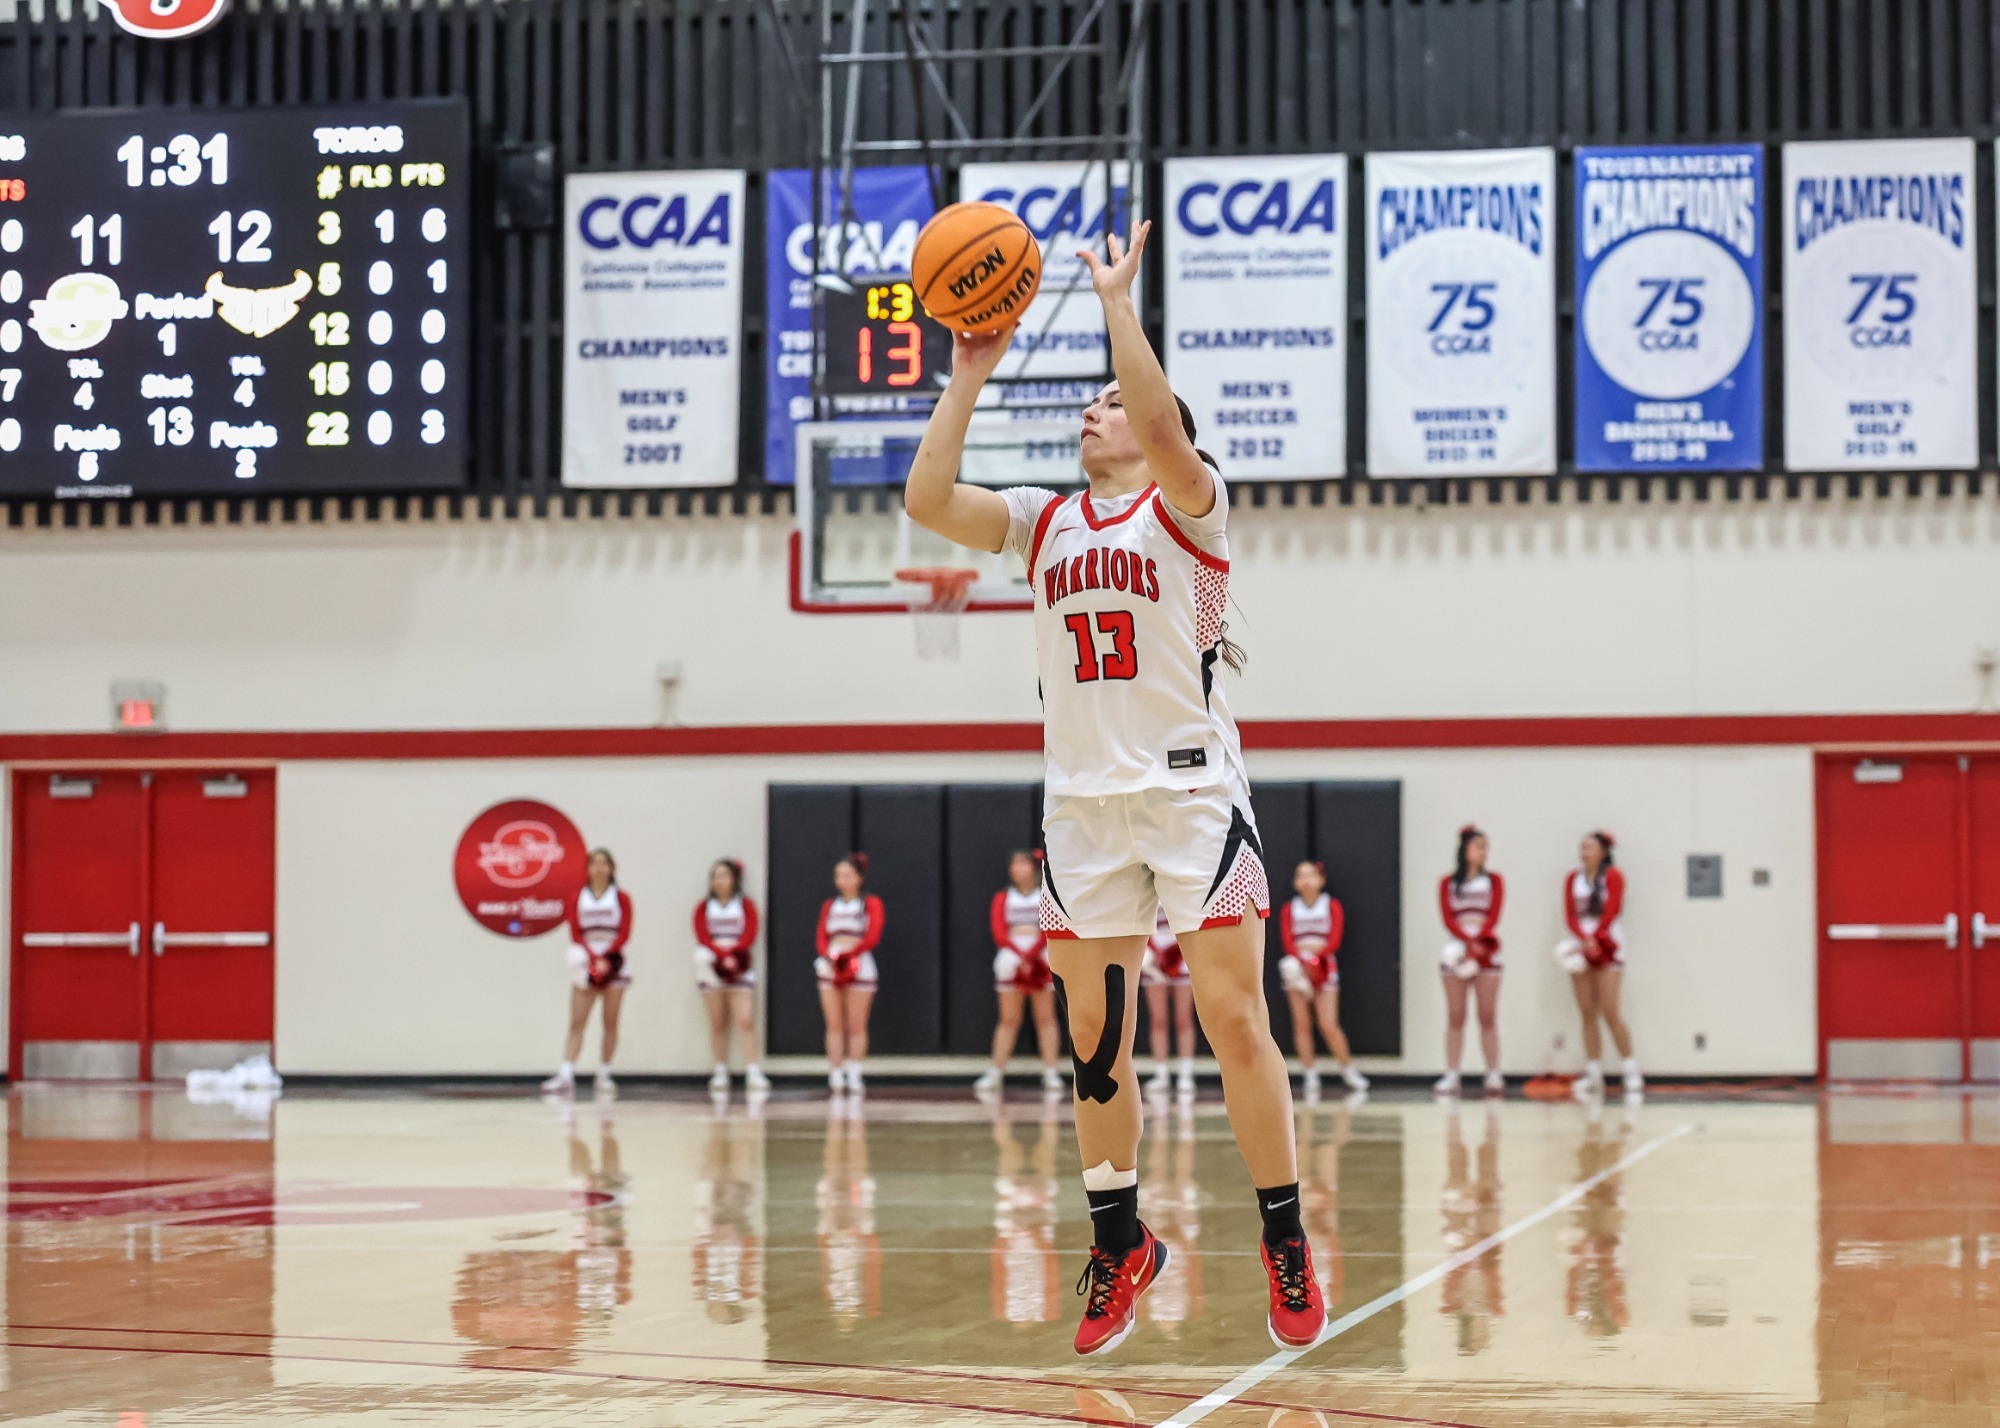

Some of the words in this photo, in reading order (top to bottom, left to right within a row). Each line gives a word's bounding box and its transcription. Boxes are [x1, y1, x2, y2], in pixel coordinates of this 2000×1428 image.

[313, 126, 404, 154] TOROS
[117, 132, 228, 187] 1:31
[350, 164, 392, 188] FLS
[400, 162, 445, 187] PTS
[1583, 155, 1755, 177] TOURNAMENT
[579, 193, 731, 250] CCAA
[1178, 179, 1335, 236] CCAA
[1378, 184, 1542, 261] CHAMPIONS
[1582, 176, 1756, 261] CHAMPIONS
[1796, 173, 1963, 252] CHAMPIONS
[0, 219, 23, 252] 0
[71, 213, 122, 266] 11
[208, 210, 272, 263] 12
[317, 211, 341, 245] 3
[375, 209, 394, 243] 1
[421, 208, 447, 242] 6
[0, 270, 22, 303] 0
[317, 262, 341, 296] 5
[368, 260, 393, 295] 0
[427, 259, 447, 293] 1
[949, 246, 1006, 300] NCAA
[135, 293, 213, 320] Period
[1427, 282, 1497, 332] 75
[1635, 278, 1705, 327] 75
[1845, 273, 1918, 324] 75
[0, 319, 22, 352] 0
[158, 323, 176, 356] 1
[308, 311, 350, 346] 12
[368, 310, 393, 345] 0
[421, 309, 446, 344] 0
[1178, 327, 1334, 350] CHAMPIONS
[1639, 331, 1699, 351] CCAA
[1851, 327, 1912, 347] CCAA
[579, 336, 729, 359] CHAMPIONS
[858, 322, 922, 386] 13
[1431, 335, 1491, 355] CCAA
[0, 368, 22, 402] 7
[141, 374, 193, 398] Shot
[233, 378, 256, 407] 4
[308, 361, 350, 396] 15
[368, 360, 393, 395] 0
[420, 359, 446, 394] 0
[1221, 381, 1291, 397] MEN'S
[73, 382, 95, 410] 4
[620, 389, 686, 405] MEN'S
[1635, 402, 1703, 420] MEN'S
[1847, 401, 1912, 415] MEN'S
[147, 406, 194, 446] 13
[306, 411, 350, 446] 22
[367, 410, 392, 445] 0
[420, 409, 445, 444] 3
[627, 415, 678, 432] GOLF
[1215, 409, 1297, 425] SOCCER
[1604, 420, 1734, 442] BASKETBALL
[0, 418, 21, 451] 0
[54, 424, 121, 451] Fouls
[210, 420, 278, 448] Fouls
[1228, 438, 1283, 459] 2012
[235, 448, 256, 478] 2
[624, 444, 682, 463] 2007
[1044, 547, 1160, 609] WARRIORS
[1064, 610, 1138, 683] 13
[1194, 752, 1204, 763] M
